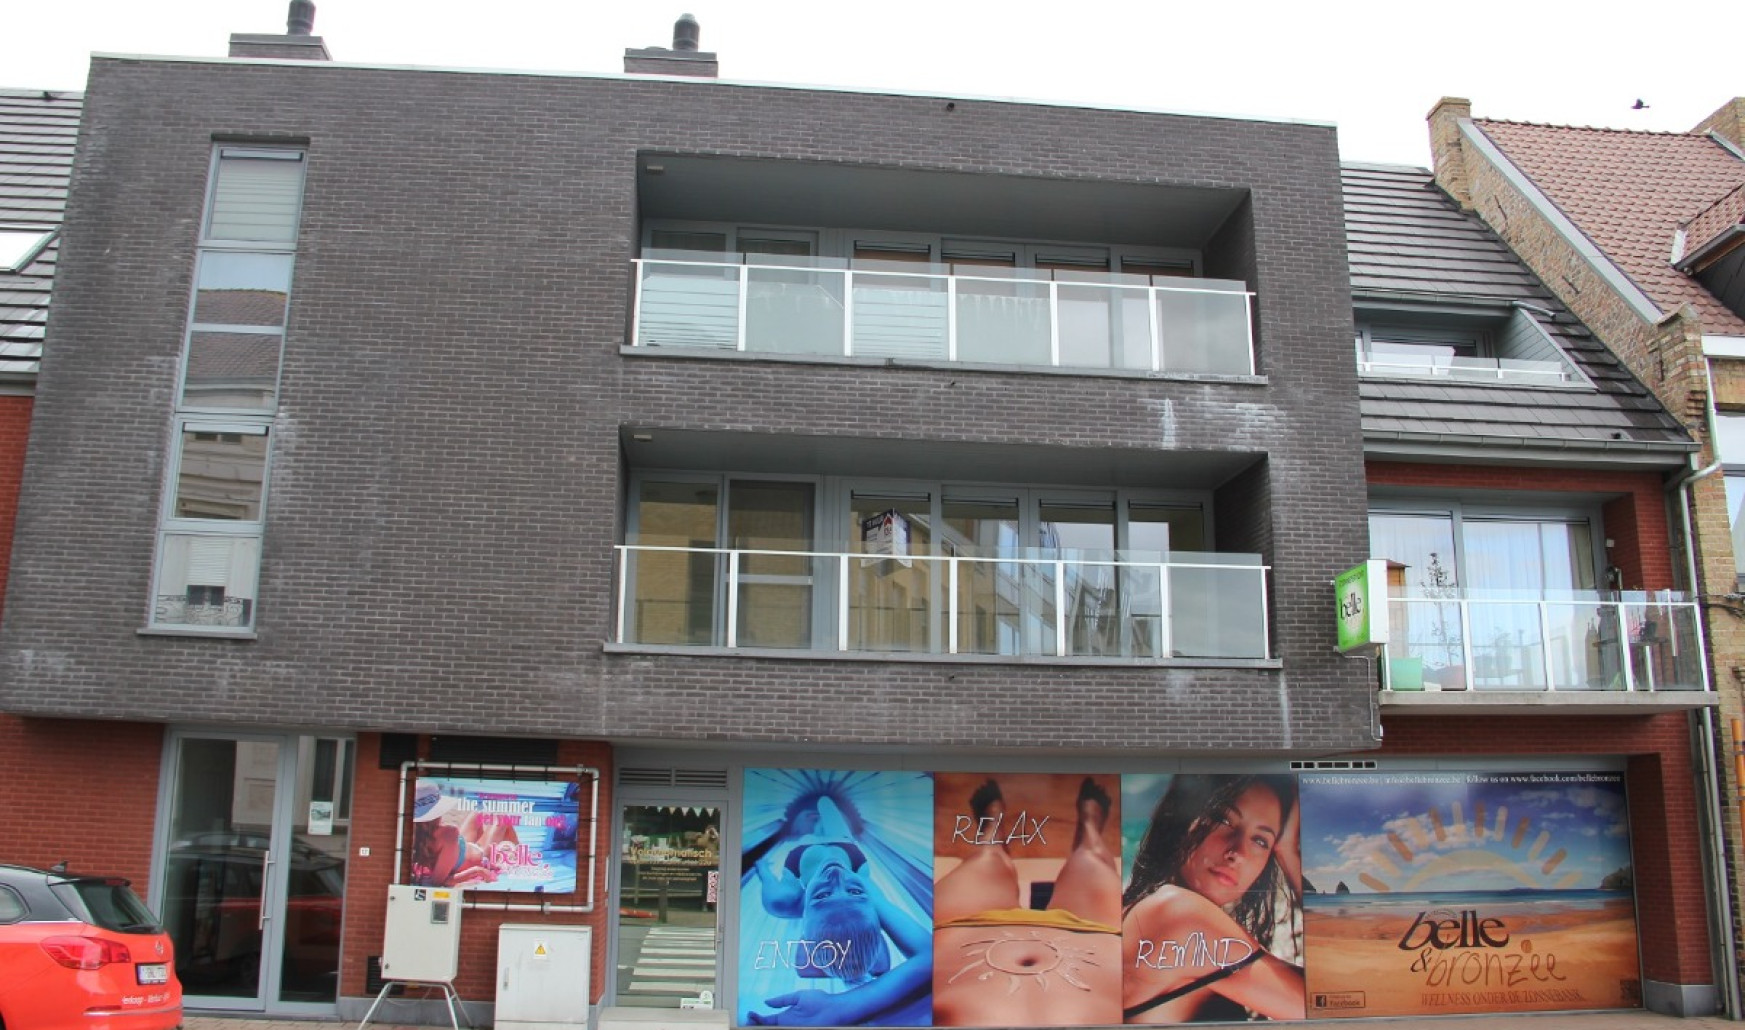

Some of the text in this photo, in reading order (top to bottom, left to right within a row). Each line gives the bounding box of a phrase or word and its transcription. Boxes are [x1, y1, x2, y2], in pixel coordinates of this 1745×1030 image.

[457, 797, 535, 814] the summer
[952, 812, 1049, 846] RELAX
[490, 844, 543, 866] belle
[1398, 909, 1510, 951] belle
[754, 939, 853, 971] ENJOY
[1137, 932, 1255, 970] REMIND
[1410, 947, 1432, 973] &
